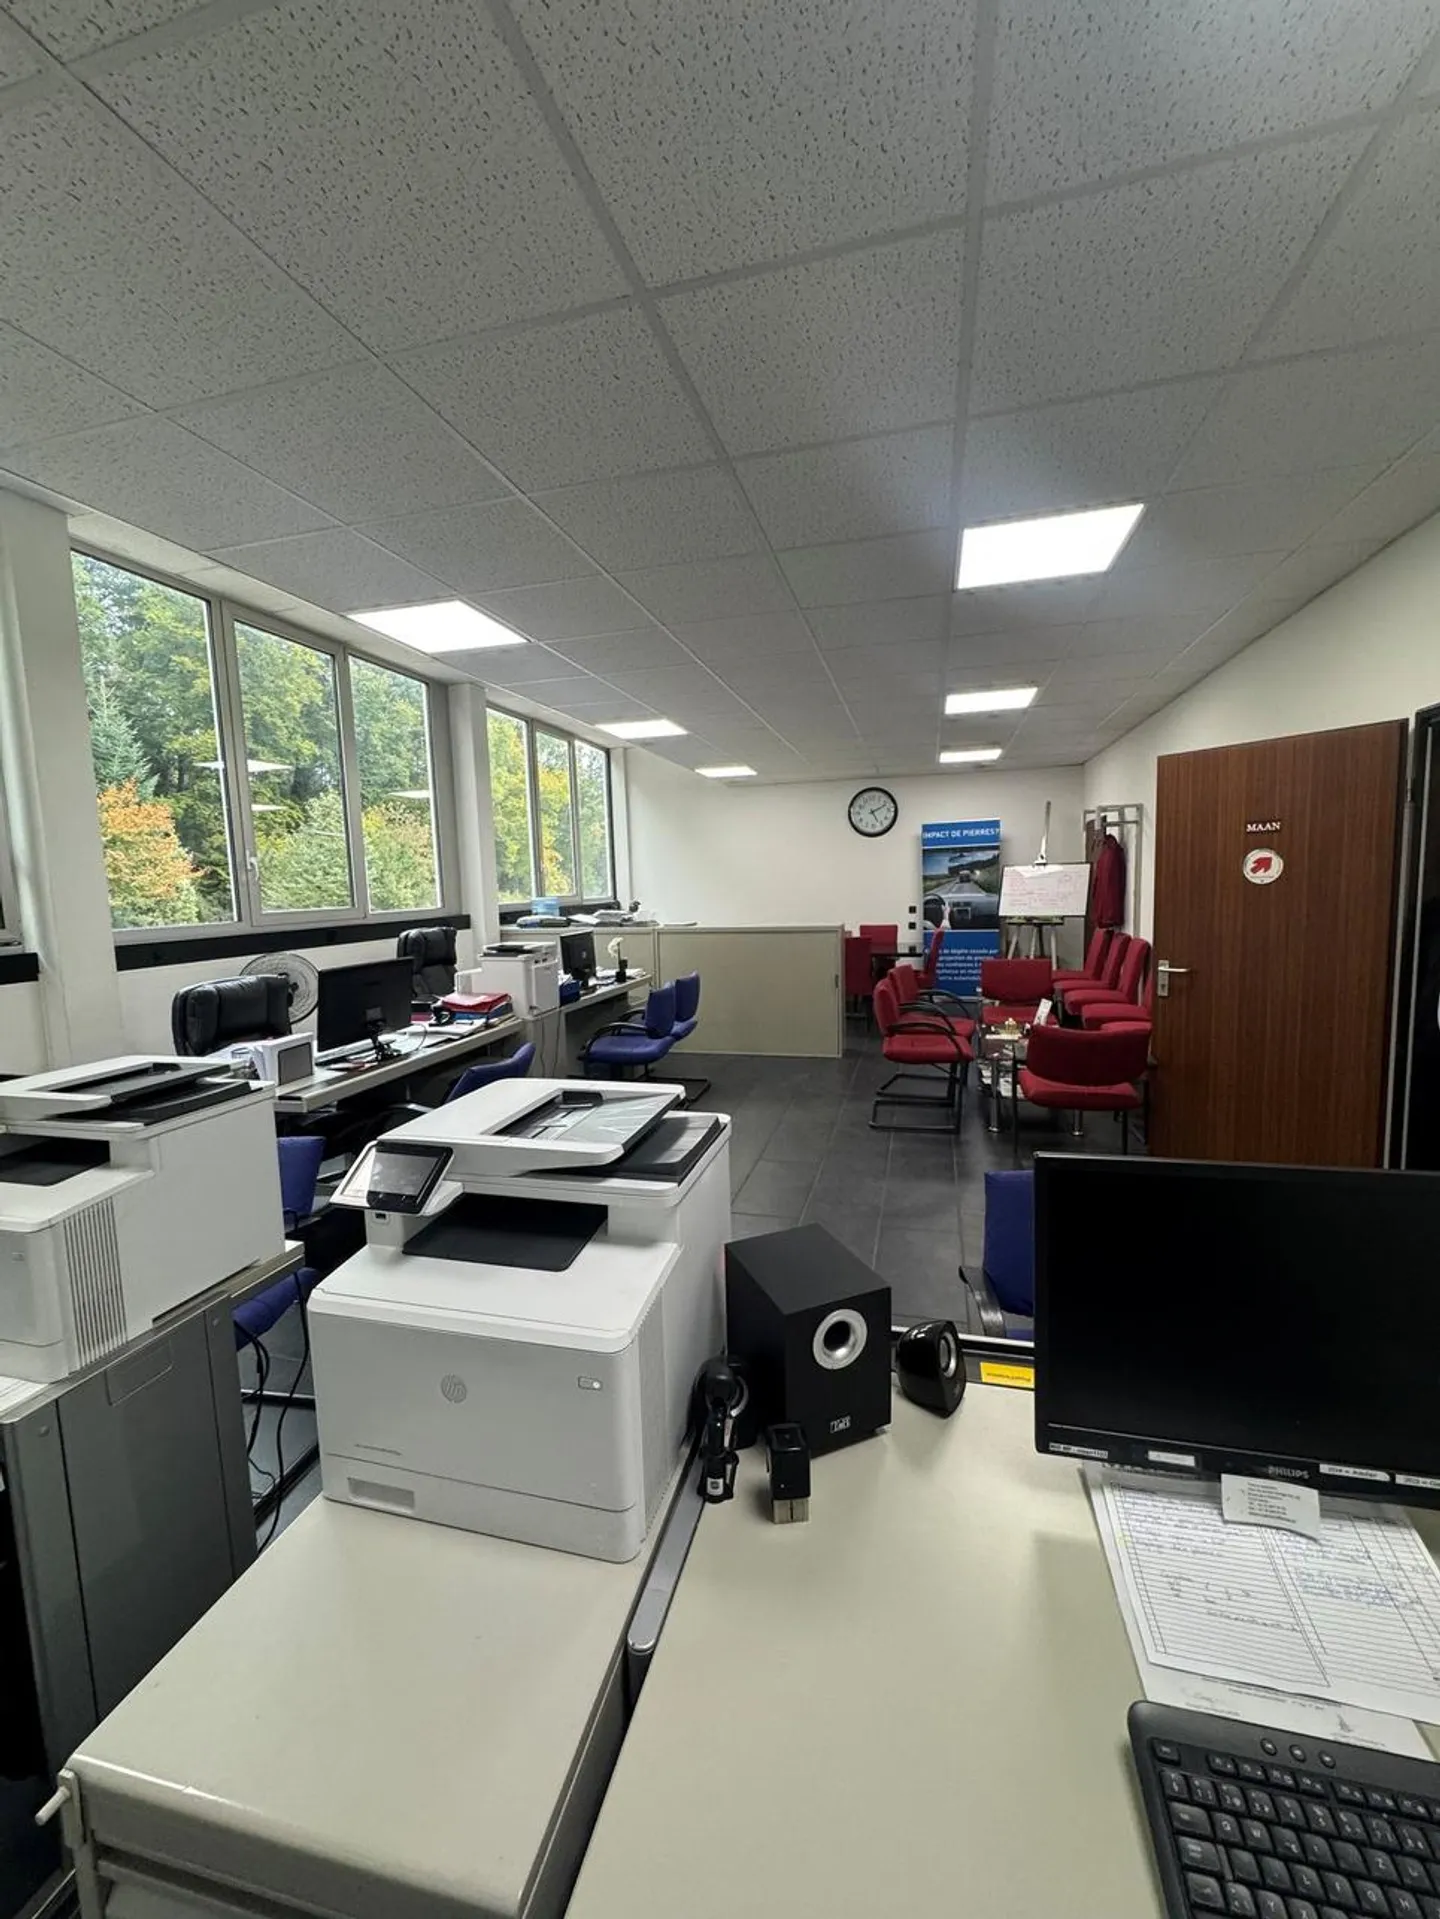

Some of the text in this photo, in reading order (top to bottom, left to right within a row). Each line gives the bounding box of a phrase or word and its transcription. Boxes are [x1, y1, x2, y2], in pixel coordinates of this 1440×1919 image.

[1246, 822, 1281, 832] MAAN
[922, 830, 949, 839] IMPACT
[951, 829, 961, 838] DE
[1268, 1466, 1310, 1479] PHILIPS
